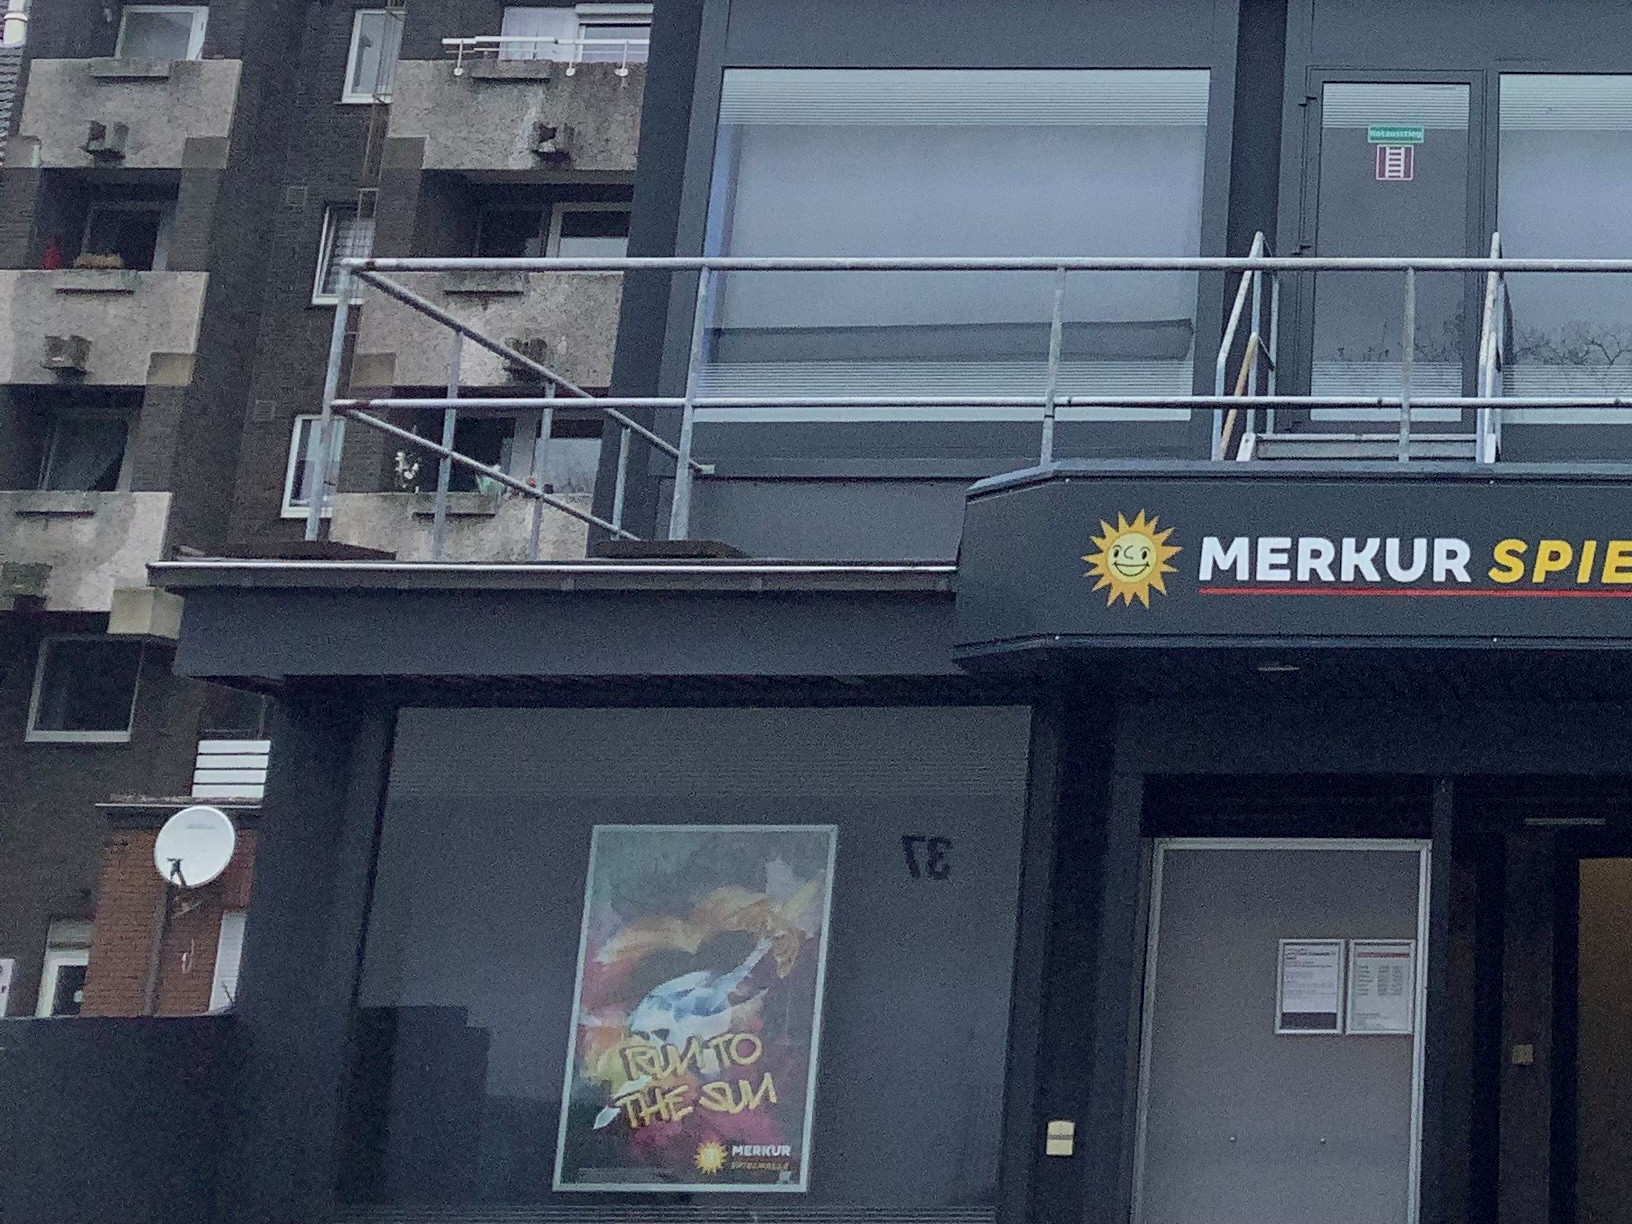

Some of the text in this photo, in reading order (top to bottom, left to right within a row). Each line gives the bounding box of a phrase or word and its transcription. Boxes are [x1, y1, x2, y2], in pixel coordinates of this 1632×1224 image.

[1370, 129, 1422, 139] Notausstieg
[1199, 536, 1472, 582] MERKUR
[622, 1031, 763, 1080] RUN TO
[613, 1072, 778, 1129] THE SUN
[731, 1144, 791, 1157] MERKUR
